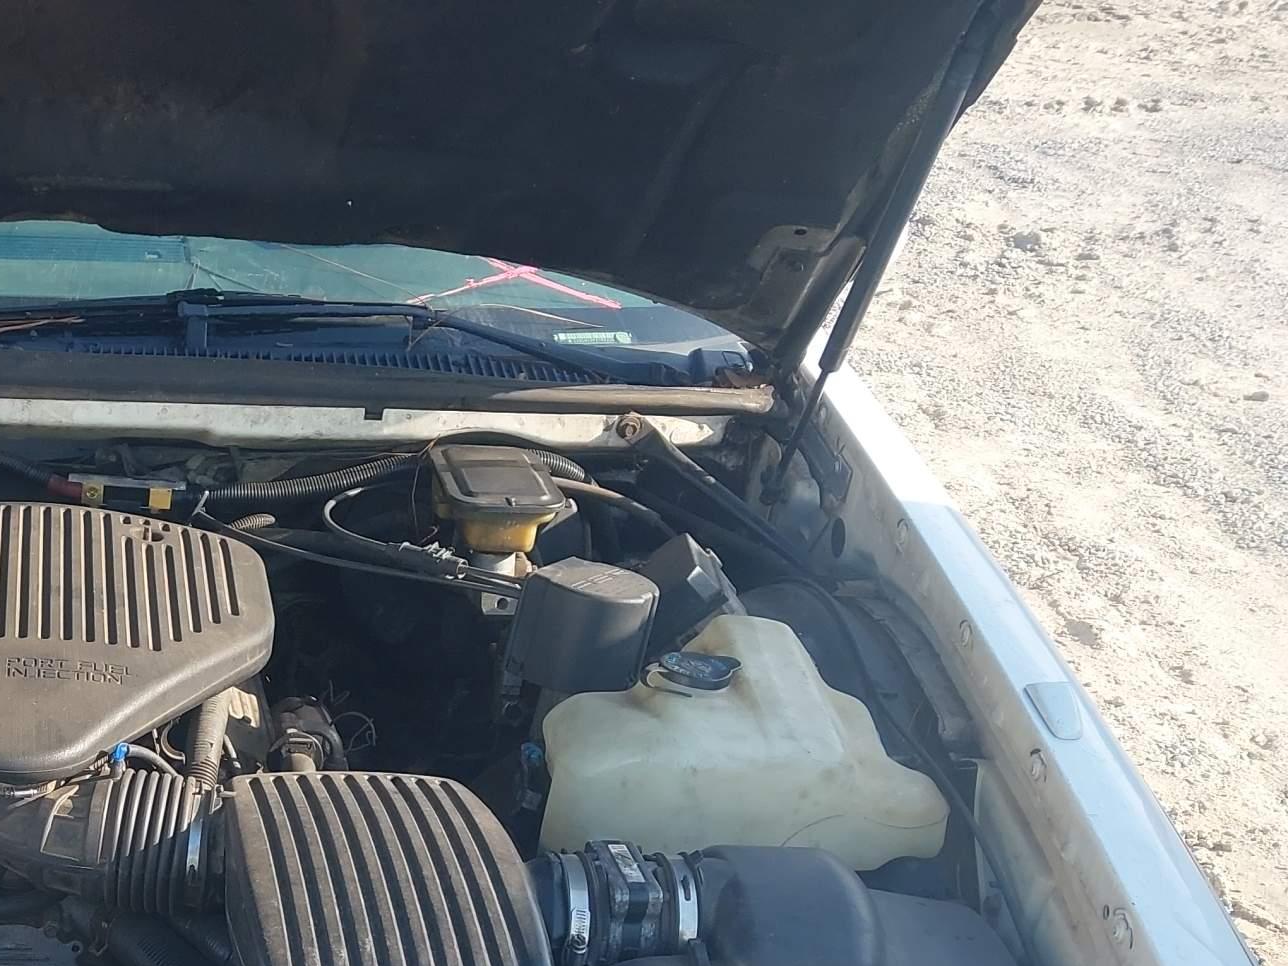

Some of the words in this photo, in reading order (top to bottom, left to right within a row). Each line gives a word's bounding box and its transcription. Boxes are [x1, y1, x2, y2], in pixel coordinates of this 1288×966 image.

[6, 656, 69, 670] PORT
[78, 659, 132, 677] FUEL
[6, 667, 124, 686] INJECTION
